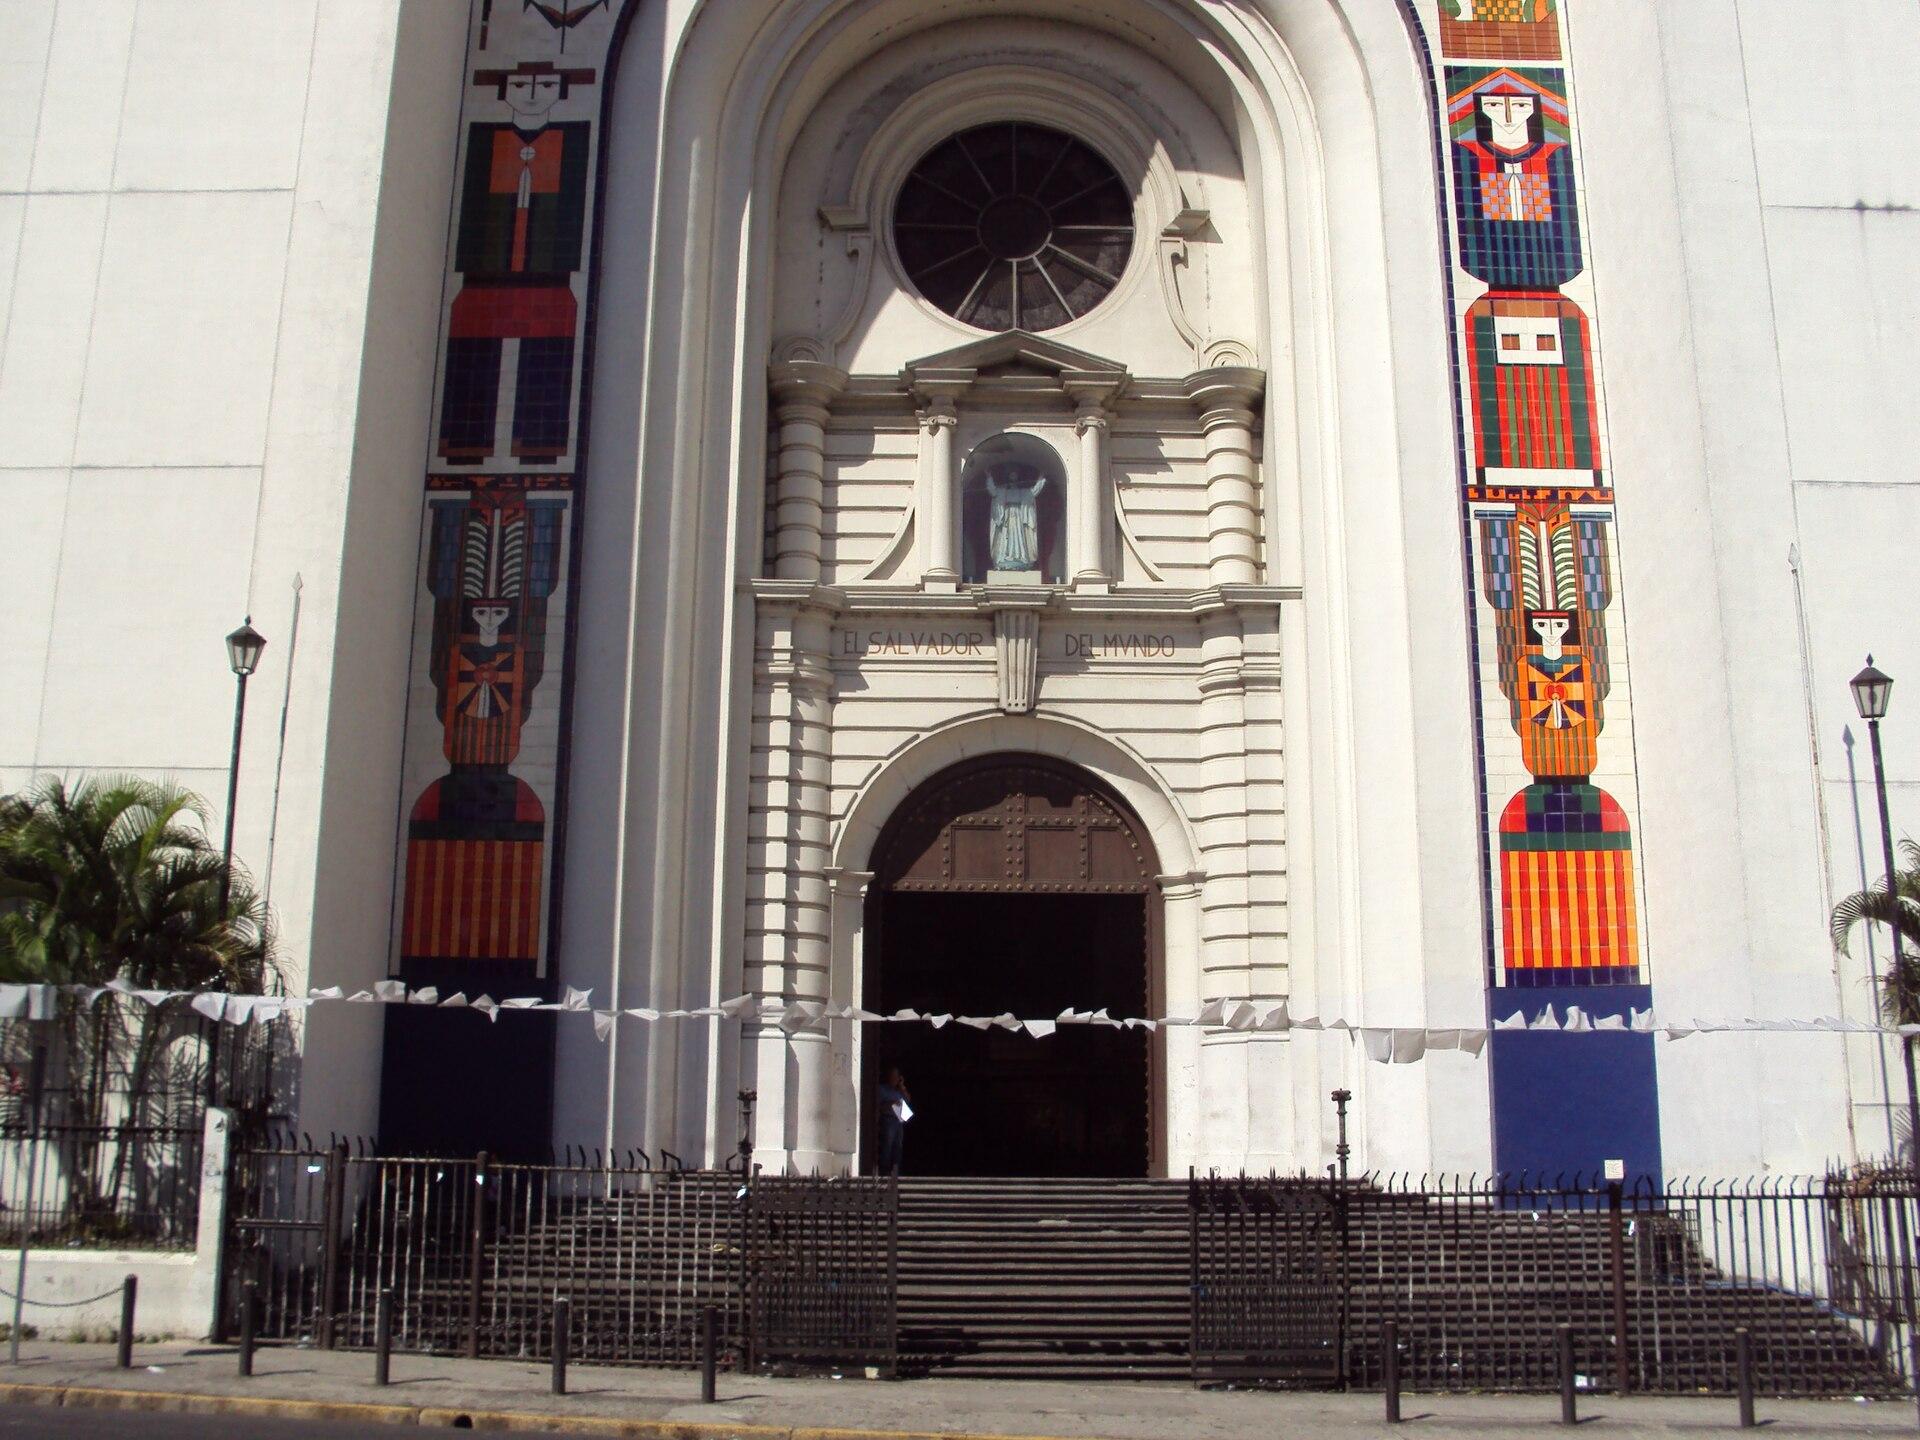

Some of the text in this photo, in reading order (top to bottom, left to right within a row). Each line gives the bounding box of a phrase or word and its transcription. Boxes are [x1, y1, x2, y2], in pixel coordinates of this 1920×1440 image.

[844, 631, 865, 655] EL
[868, 631, 984, 656] SALVADOR
[1065, 633, 1101, 657] DEL
